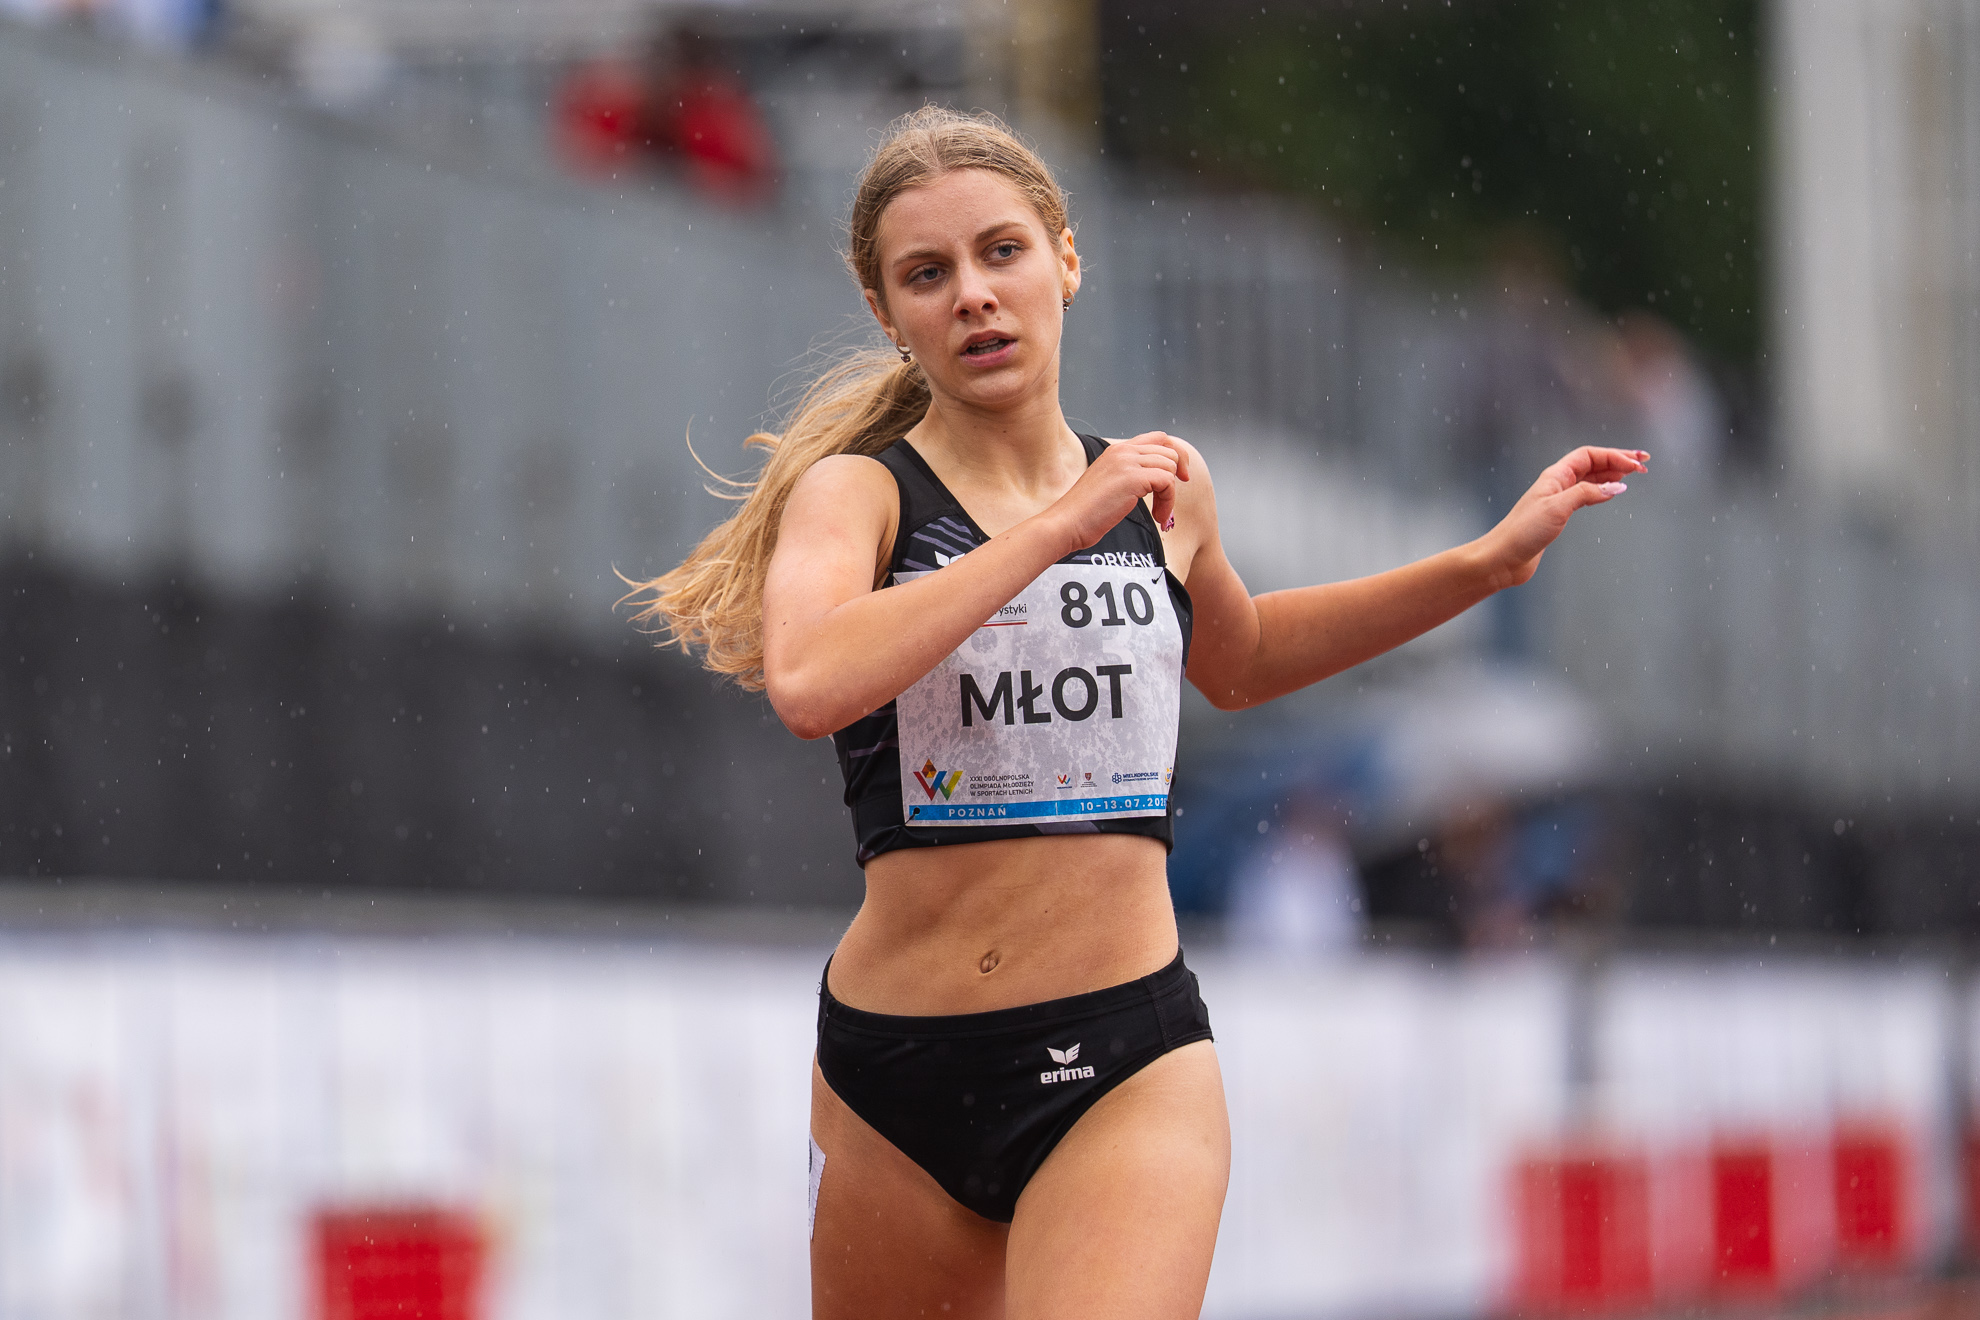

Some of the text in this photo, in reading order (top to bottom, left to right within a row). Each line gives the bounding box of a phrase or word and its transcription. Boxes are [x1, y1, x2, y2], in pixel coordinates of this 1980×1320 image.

[1090, 551, 1155, 568] ORKAN
[996, 603, 1028, 617] ystyki
[1060, 581, 1155, 628] 810
[959, 664, 1132, 727] MŁOT
[983, 774, 1030, 782] OGÓLNOPOLSKA
[948, 805, 1007, 817] POZNAŃ
[1040, 1065, 1095, 1084] erima
